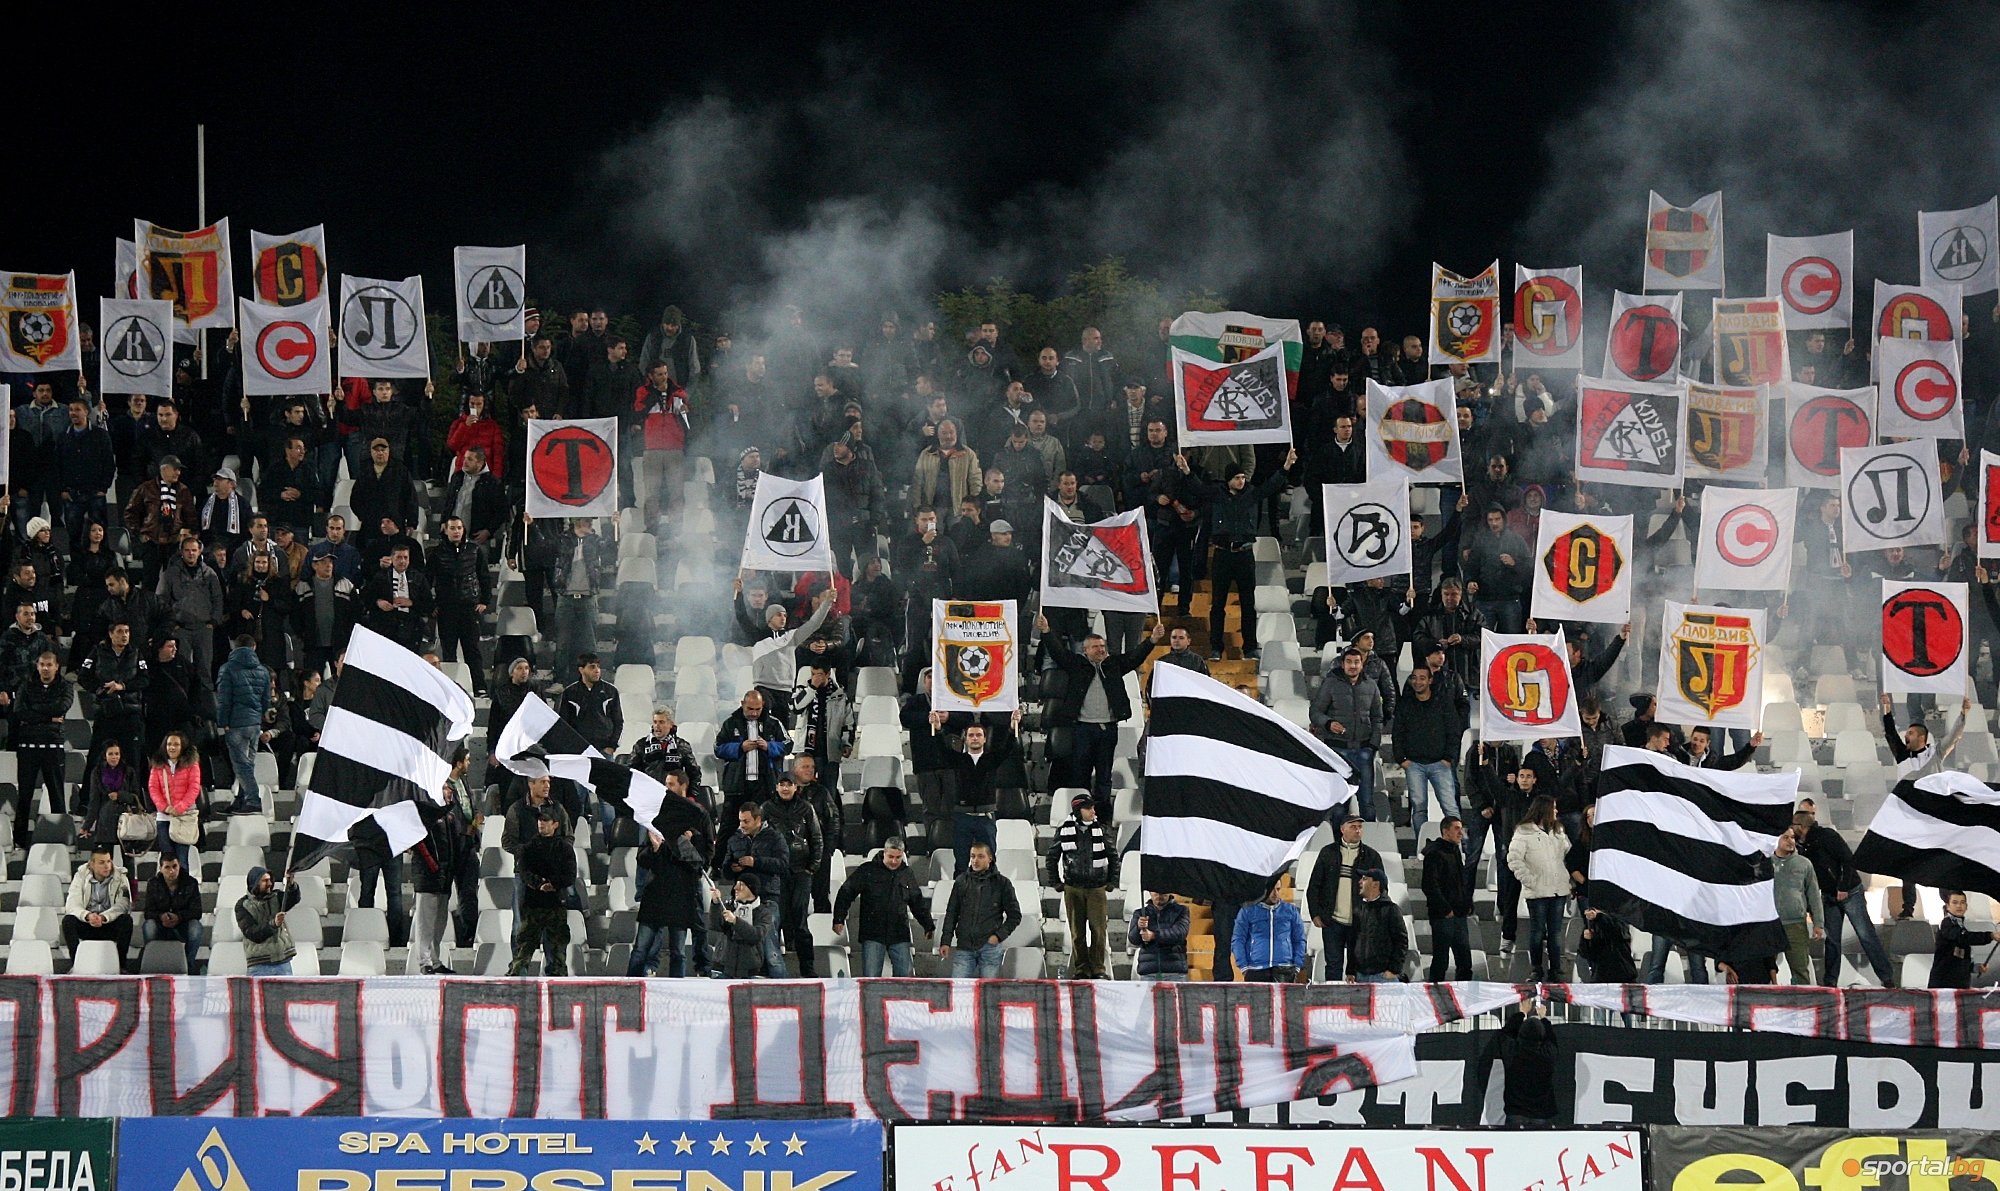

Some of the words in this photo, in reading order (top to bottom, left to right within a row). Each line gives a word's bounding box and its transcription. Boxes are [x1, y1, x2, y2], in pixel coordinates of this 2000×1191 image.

[1635, 399, 1673, 459] КЛУБЪ
[545, 437, 598, 501] Т
[1682, 624, 1750, 642] ПЛОВДИВ
[1889, 601, 1948, 669] Т
[339, 1131, 429, 1155] SPA
[443, 1132, 593, 1155] HOTEL
